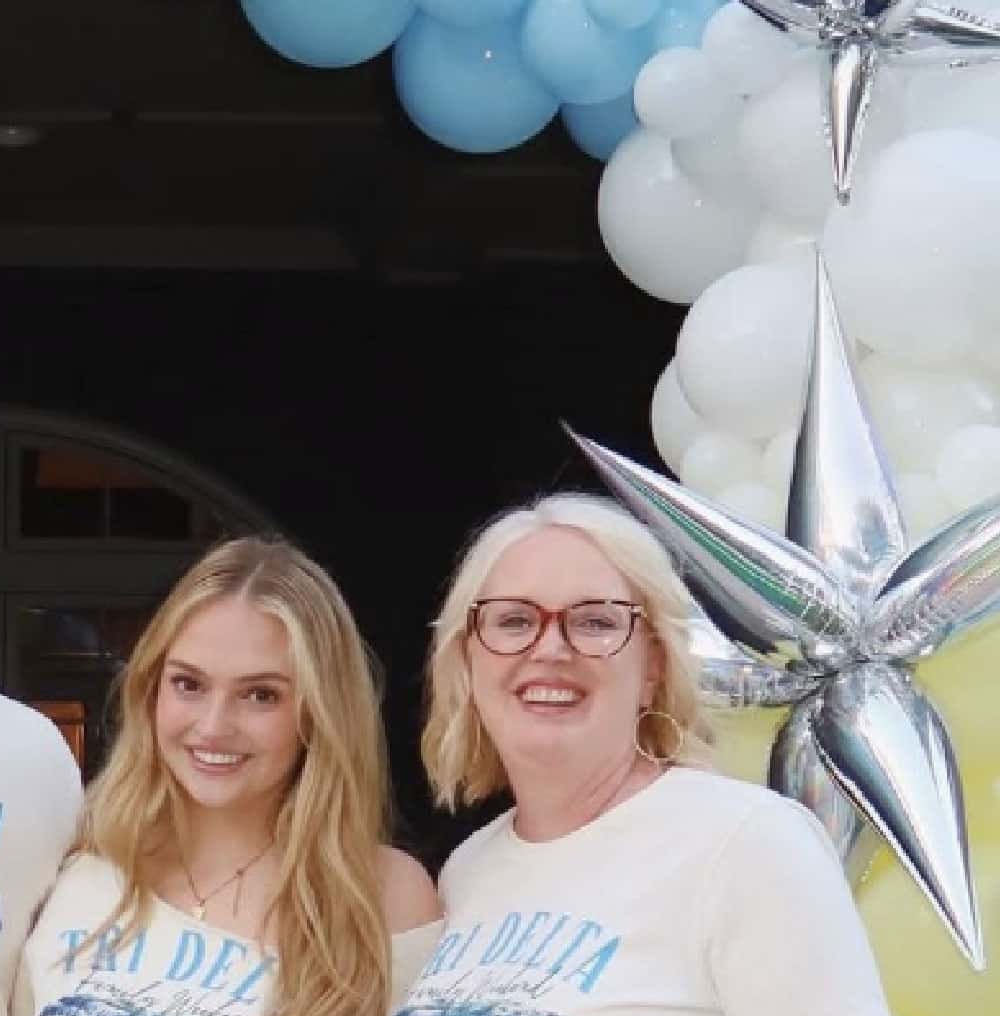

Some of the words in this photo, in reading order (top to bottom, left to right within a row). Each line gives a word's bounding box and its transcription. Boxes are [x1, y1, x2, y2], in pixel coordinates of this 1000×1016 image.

[166, 929, 278, 1004] DEL
[423, 922, 483, 978] RI
[479, 911, 623, 993] DELTA
